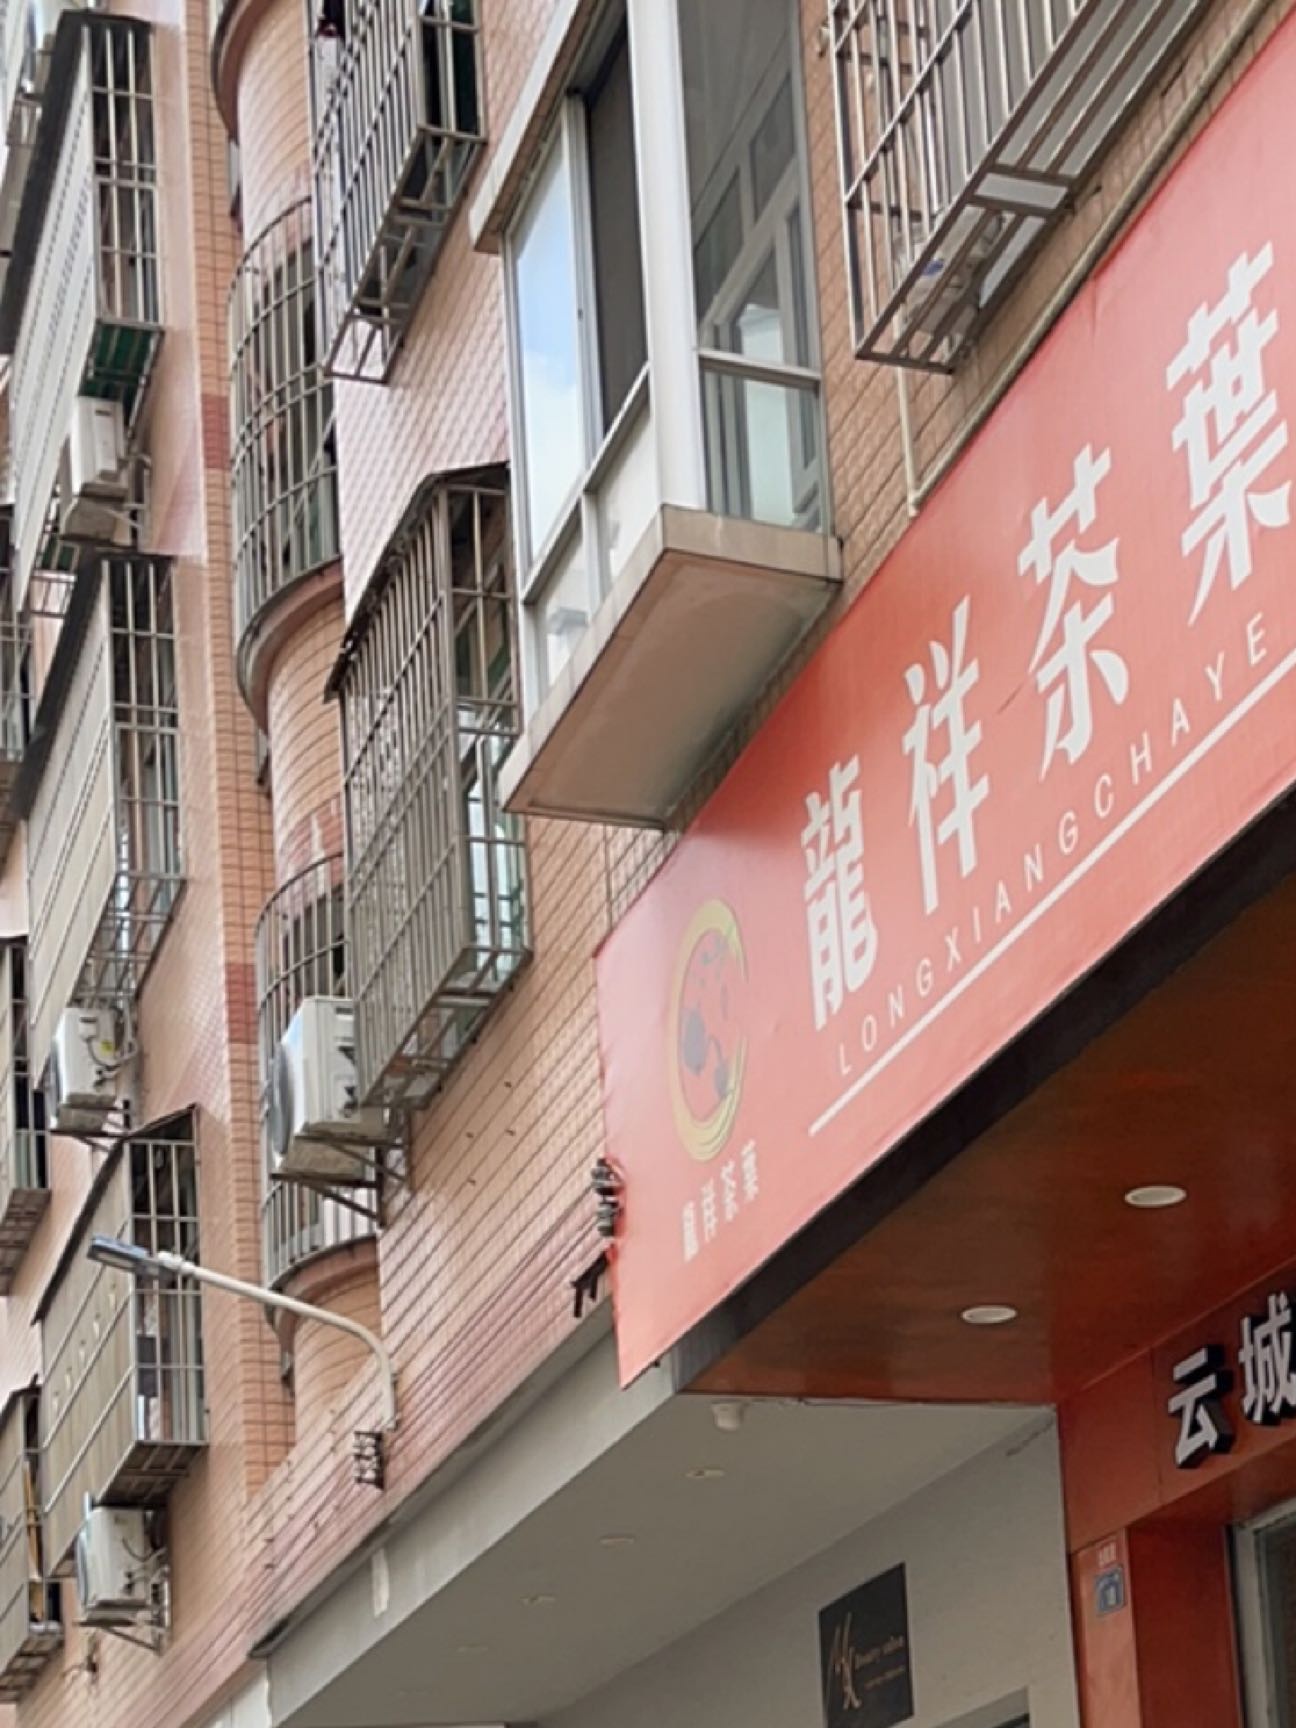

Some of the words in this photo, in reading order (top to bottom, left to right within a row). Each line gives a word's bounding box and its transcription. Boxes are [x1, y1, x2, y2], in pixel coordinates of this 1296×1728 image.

[800, 240, 1293, 1030] 龍祥茶葉
[836, 611, 1270, 1077] LONGXIANGCHAYE
